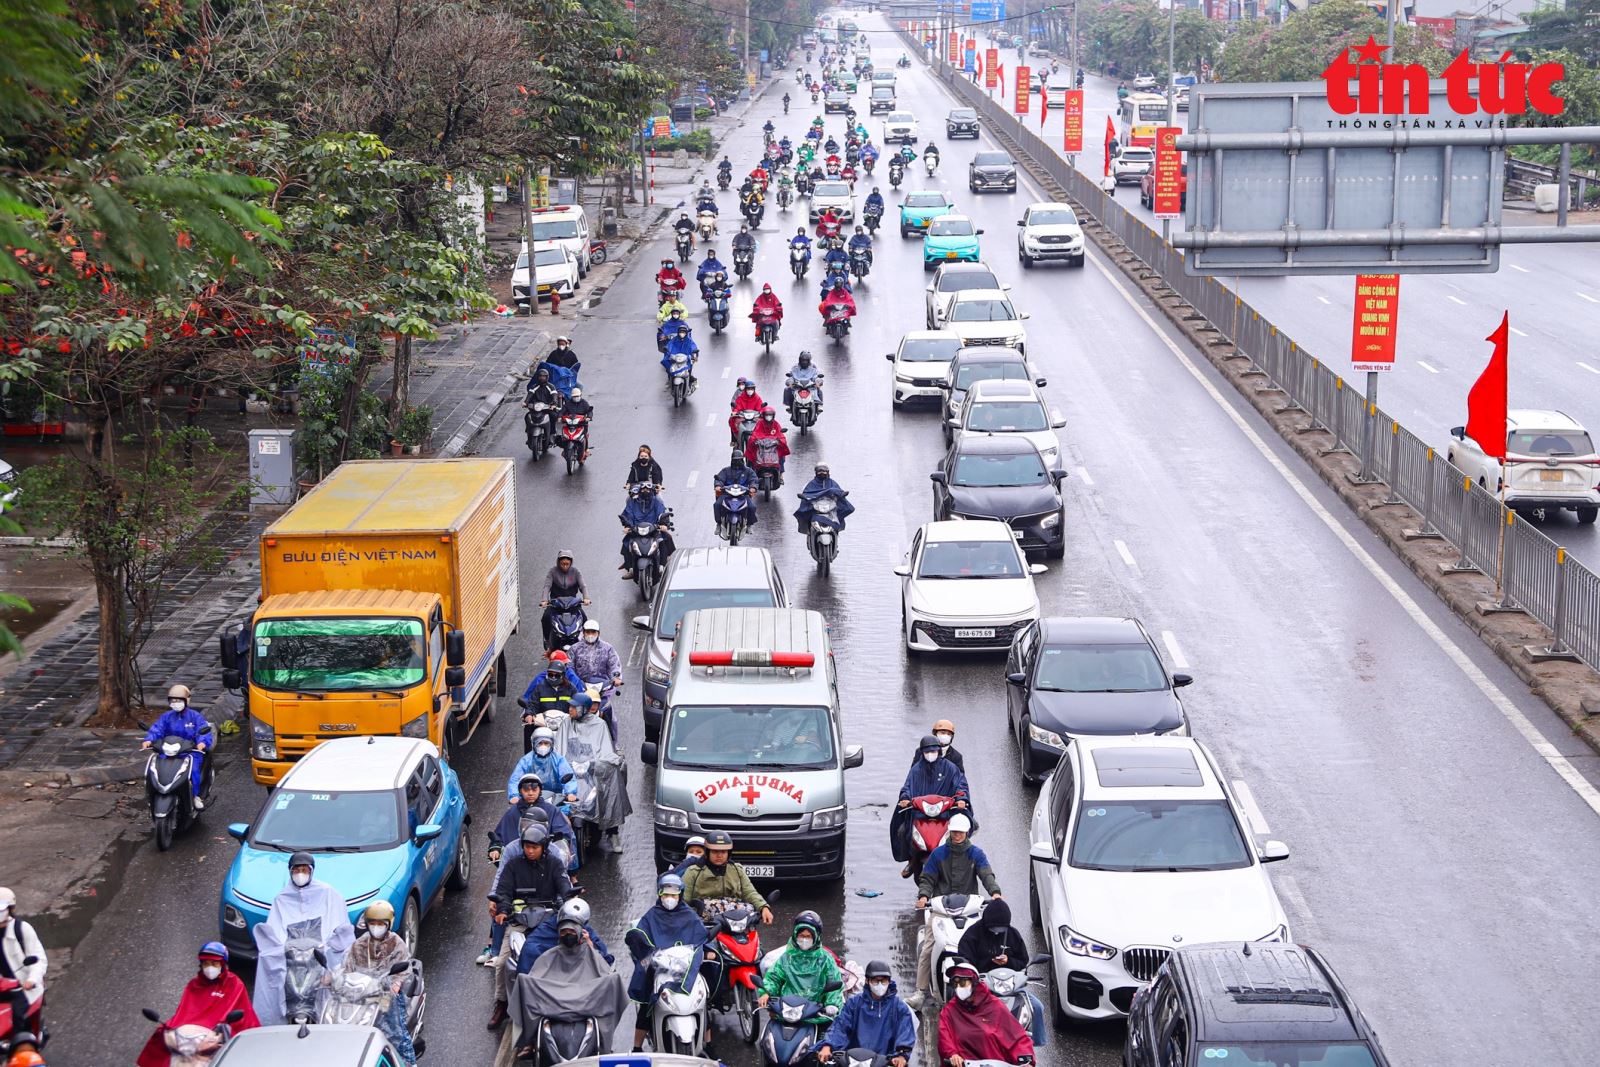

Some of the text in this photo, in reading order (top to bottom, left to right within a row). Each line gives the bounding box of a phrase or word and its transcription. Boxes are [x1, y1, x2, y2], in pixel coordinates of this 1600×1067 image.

[1365, 298, 1388, 310] VIỆT NAM
[283, 548, 437, 565] BƯU ĐIỆN VIỆT NAM
[318, 723, 357, 732] ISUZU
[311, 793, 330, 801] TAXI
